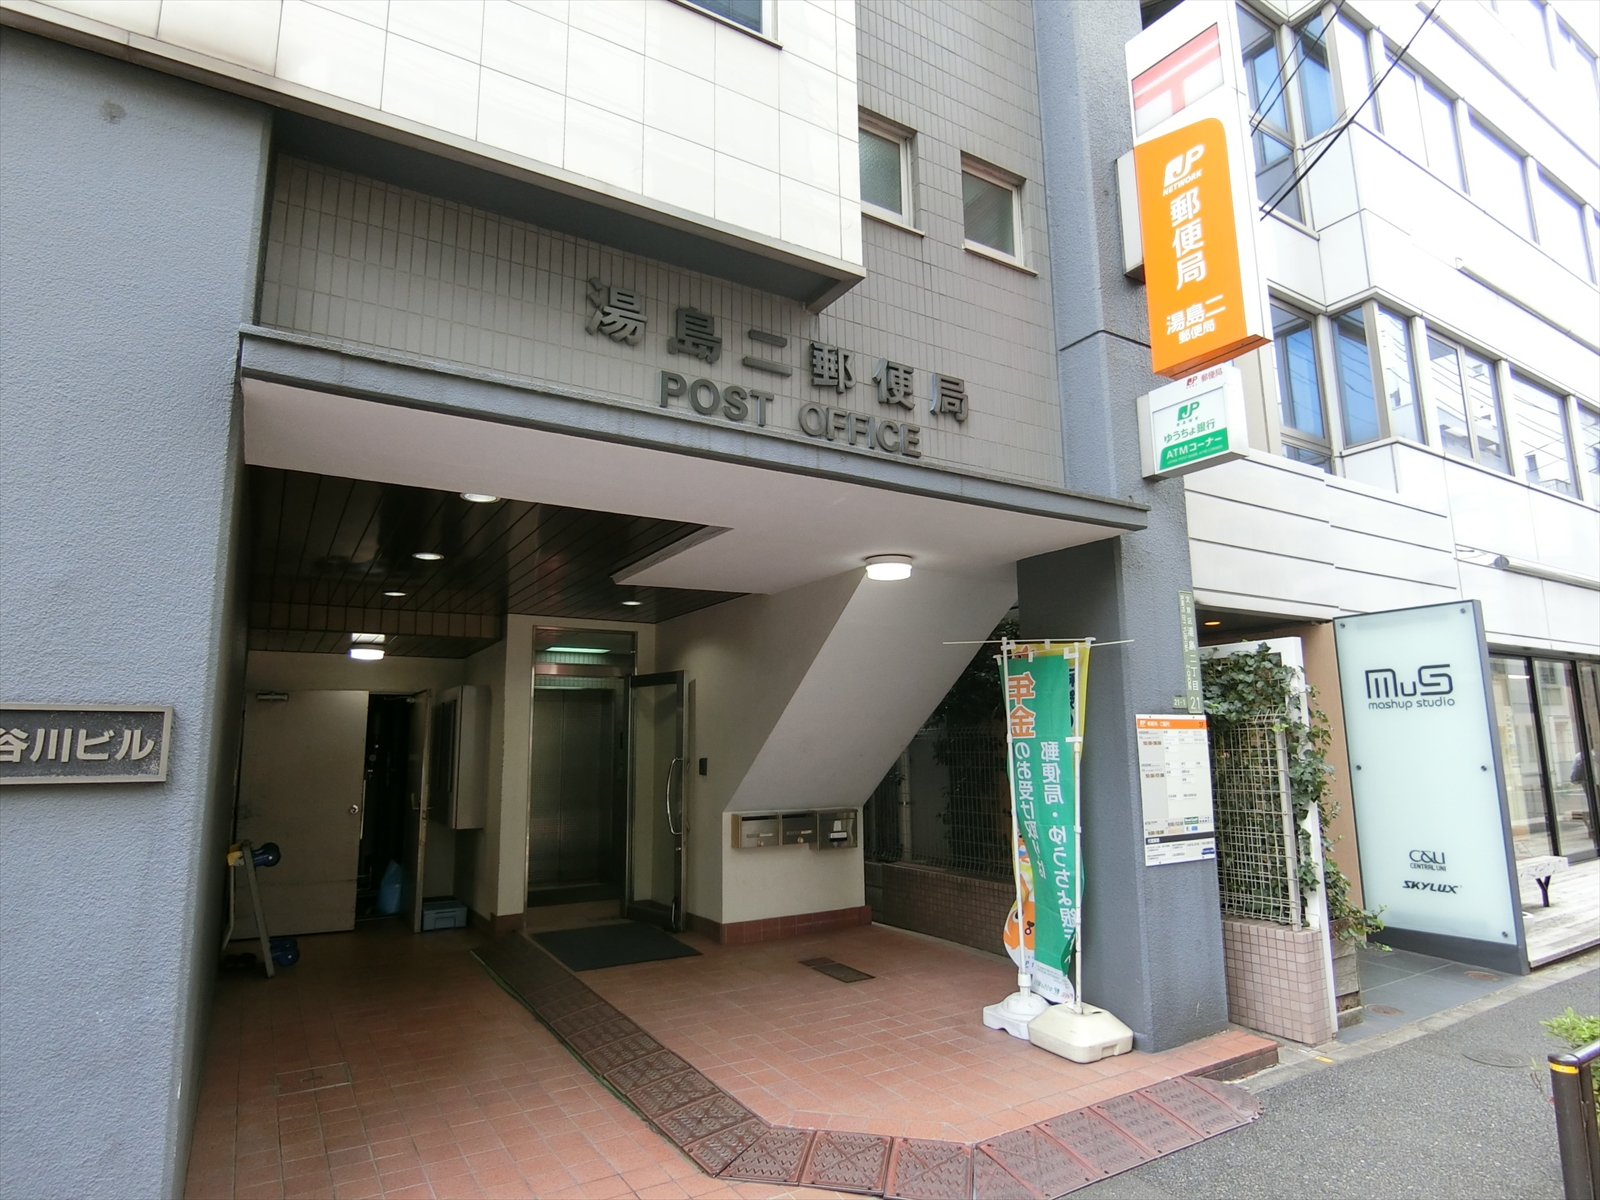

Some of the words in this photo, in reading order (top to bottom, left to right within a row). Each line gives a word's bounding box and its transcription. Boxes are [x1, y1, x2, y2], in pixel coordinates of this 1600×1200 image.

[1162, 169, 1202, 197] NETWORK
[1170, 186, 1206, 291] 郵便局
[1166, 294, 1226, 335] 湯島二
[1178, 318, 1216, 344] 郵便局
[585, 277, 969, 422] 湯島二郵便局
[659, 370, 774, 426] POST
[799, 402, 922, 458] OFFICE
[1163, 418, 1216, 444] ゆうちょ銀行
[1166, 437, 1222, 460] ATMコーナー
[1173, 698, 1186, 706] 21-1
[1190, 696, 1201, 710] 21
[1368, 699, 1413, 711] mashup
[1416, 696, 1455, 708] studio
[1410, 862, 1436, 871] CENTRAL
[1402, 880, 1459, 895] SKYLUX
